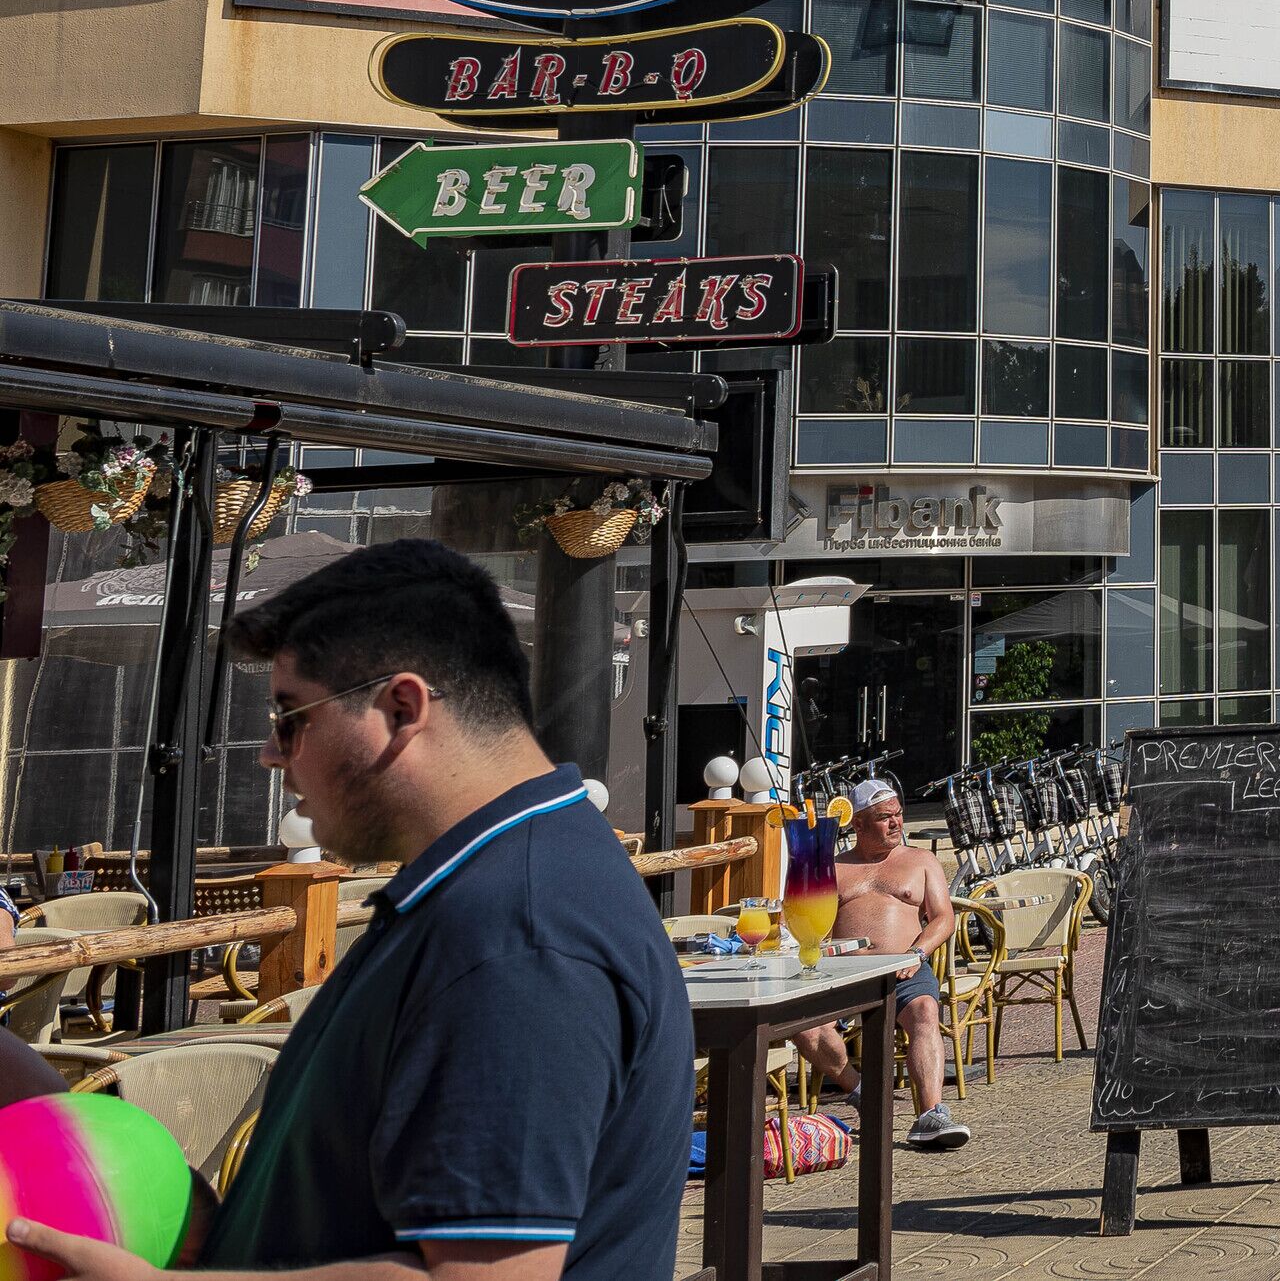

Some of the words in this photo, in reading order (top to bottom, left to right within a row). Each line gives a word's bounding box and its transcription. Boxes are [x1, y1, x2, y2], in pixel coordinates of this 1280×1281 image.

[444, 46, 708, 106] BAR-B-Q
[431, 163, 596, 220] BEER
[542, 267, 774, 331] STEAKS
[826, 484, 1005, 530] Fibank
[823, 536, 866, 553] Първа
[867, 535, 968, 551] инвестиционна
[969, 534, 1002, 548] банка
[1137, 739, 1277, 775] PREMIER
